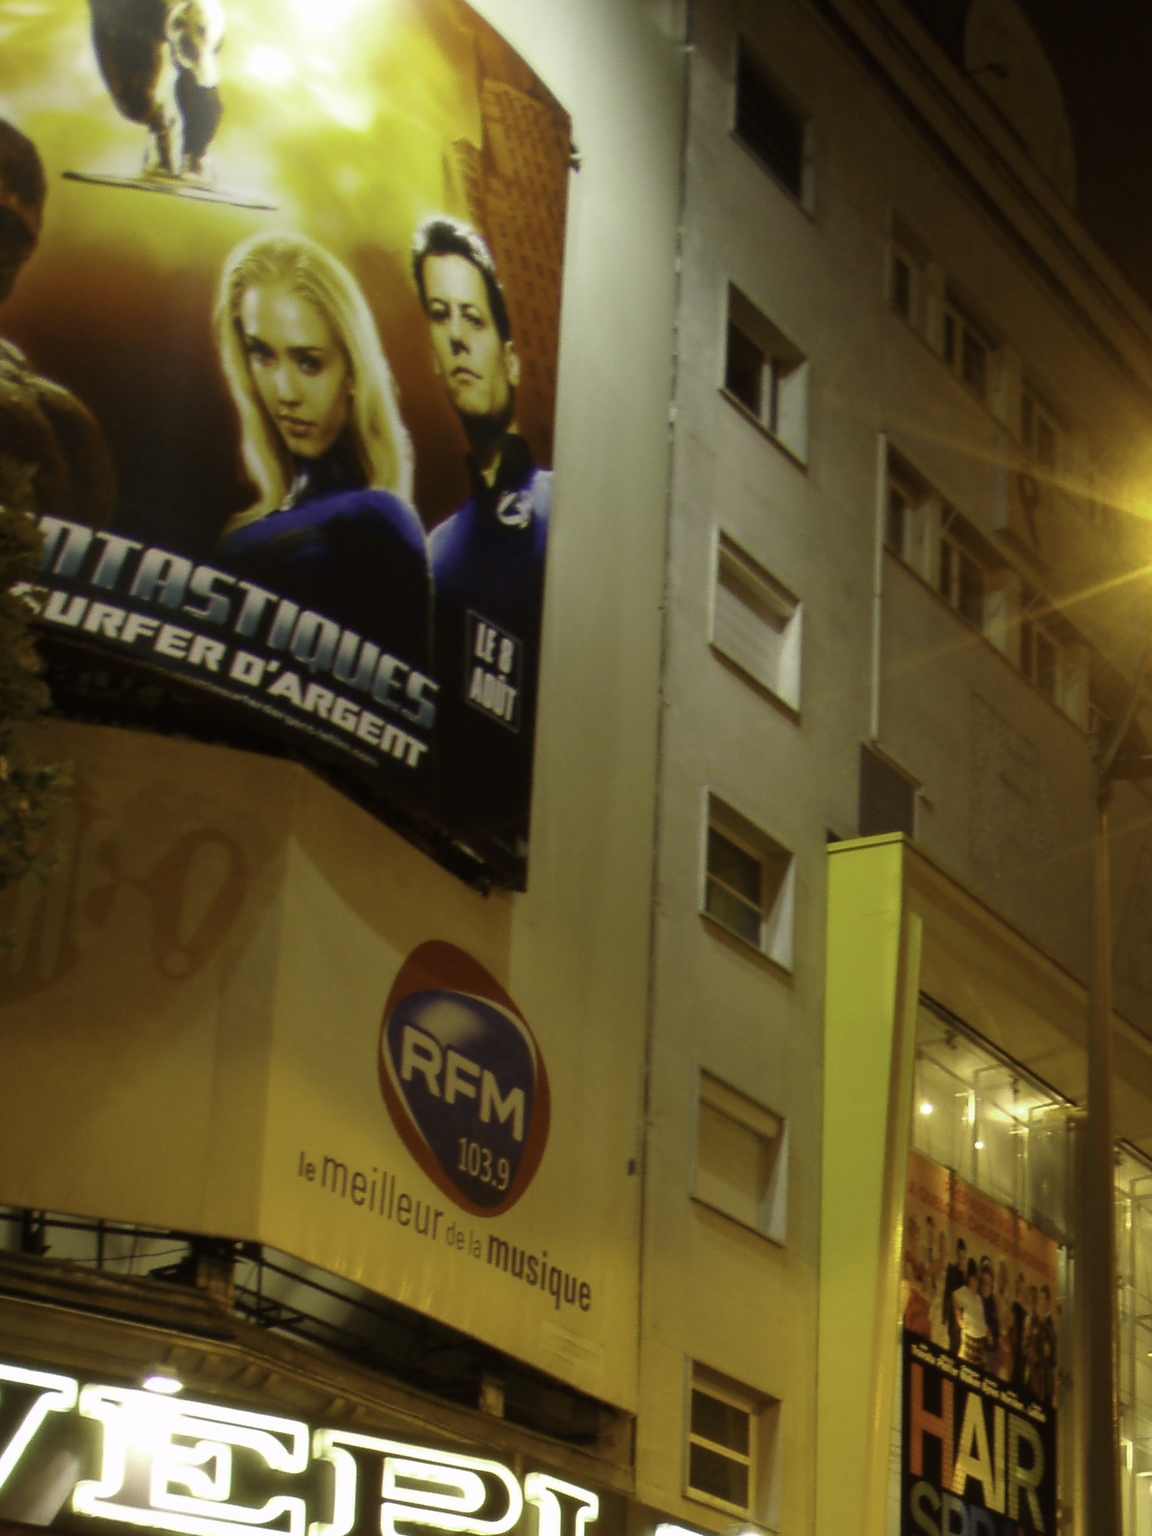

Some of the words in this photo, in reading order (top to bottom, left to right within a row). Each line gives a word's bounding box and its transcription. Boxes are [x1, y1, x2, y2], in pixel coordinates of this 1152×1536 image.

[36, 515, 441, 730] NTASTIQUES
[473, 621, 498, 664] LE
[228, 655, 429, 769] D'ARGENT
[400, 1024, 526, 1142] RFM
[458, 1137, 511, 1192] 103.9
[298, 1151, 317, 1183] le
[321, 1154, 444, 1241] meilleur
[445, 1221, 466, 1251] de
[467, 1228, 483, 1260] la
[486, 1232, 592, 1313] musique
[908, 1360, 1046, 1534] HAIR
